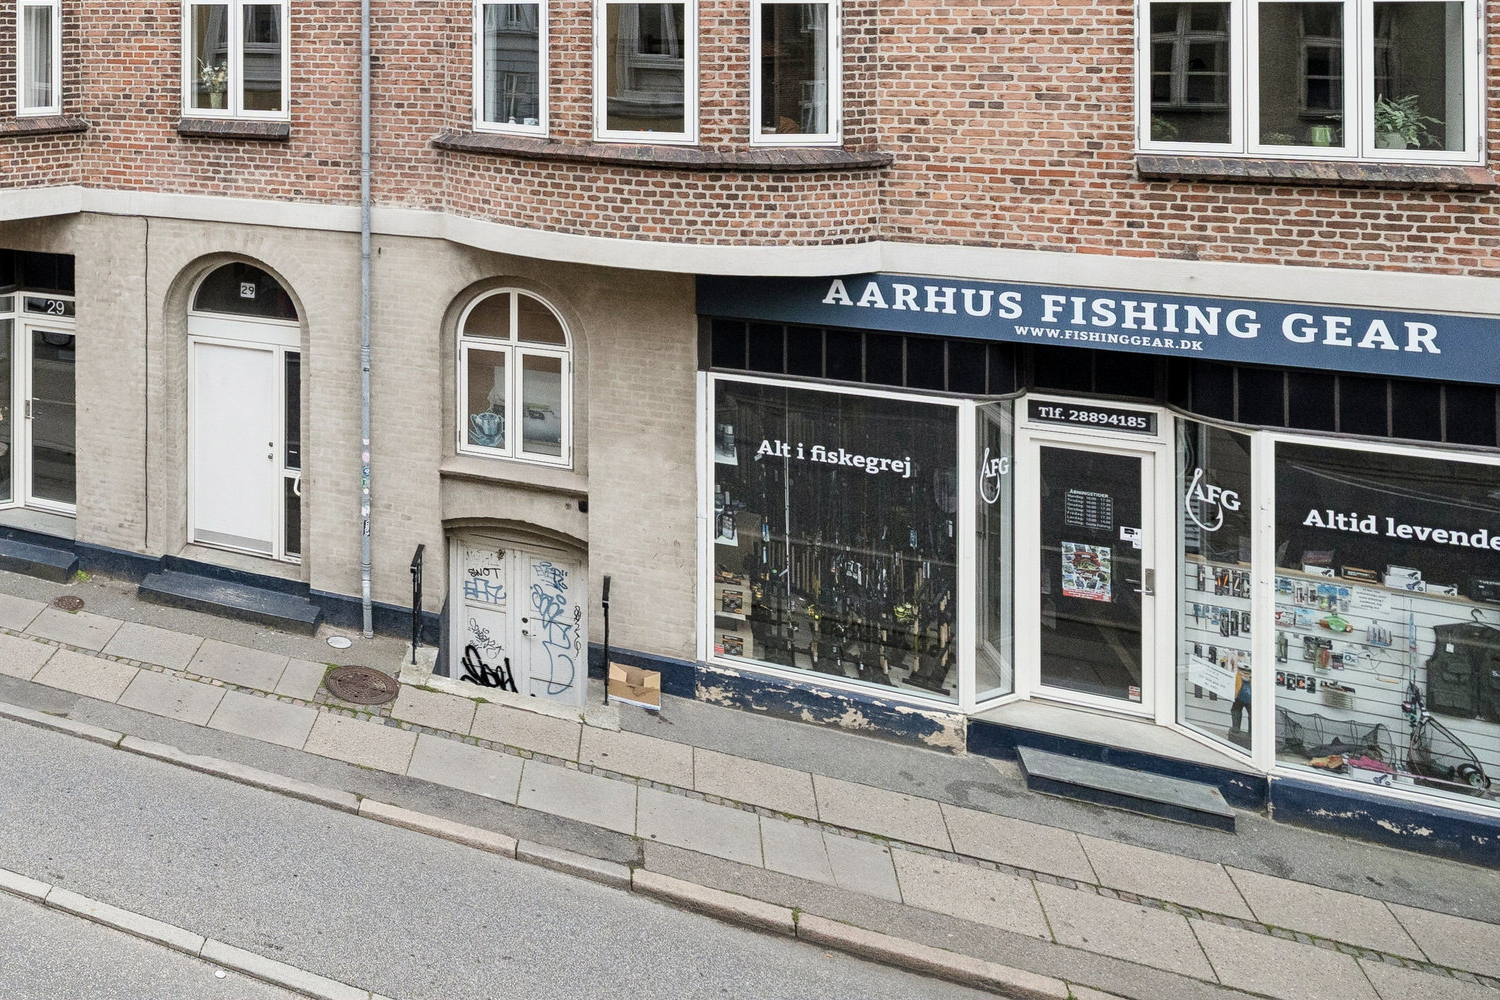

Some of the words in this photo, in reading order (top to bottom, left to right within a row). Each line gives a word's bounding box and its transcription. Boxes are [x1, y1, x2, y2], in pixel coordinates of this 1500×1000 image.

[241, 285, 254, 295] 29
[47, 301, 65, 316] 29
[822, 279, 1023, 319] AARHUS
[1041, 294, 1261, 339] FISHING
[1282, 313, 1441, 354] GEAR
[1014, 326, 1203, 351] WWW.FISHINGGEAR.DK
[1038, 406, 1065, 420] Tlf.
[1069, 409, 1147, 428] 28894185
[757, 440, 791, 458] Alt
[797, 442, 805, 460] i
[811, 444, 911, 478] fiskegrej
[983, 457, 1009, 478] AFG
[1194, 483, 1241, 511] AFG
[1303, 509, 1378, 535] Altid
[1386, 517, 1500, 551] levende
